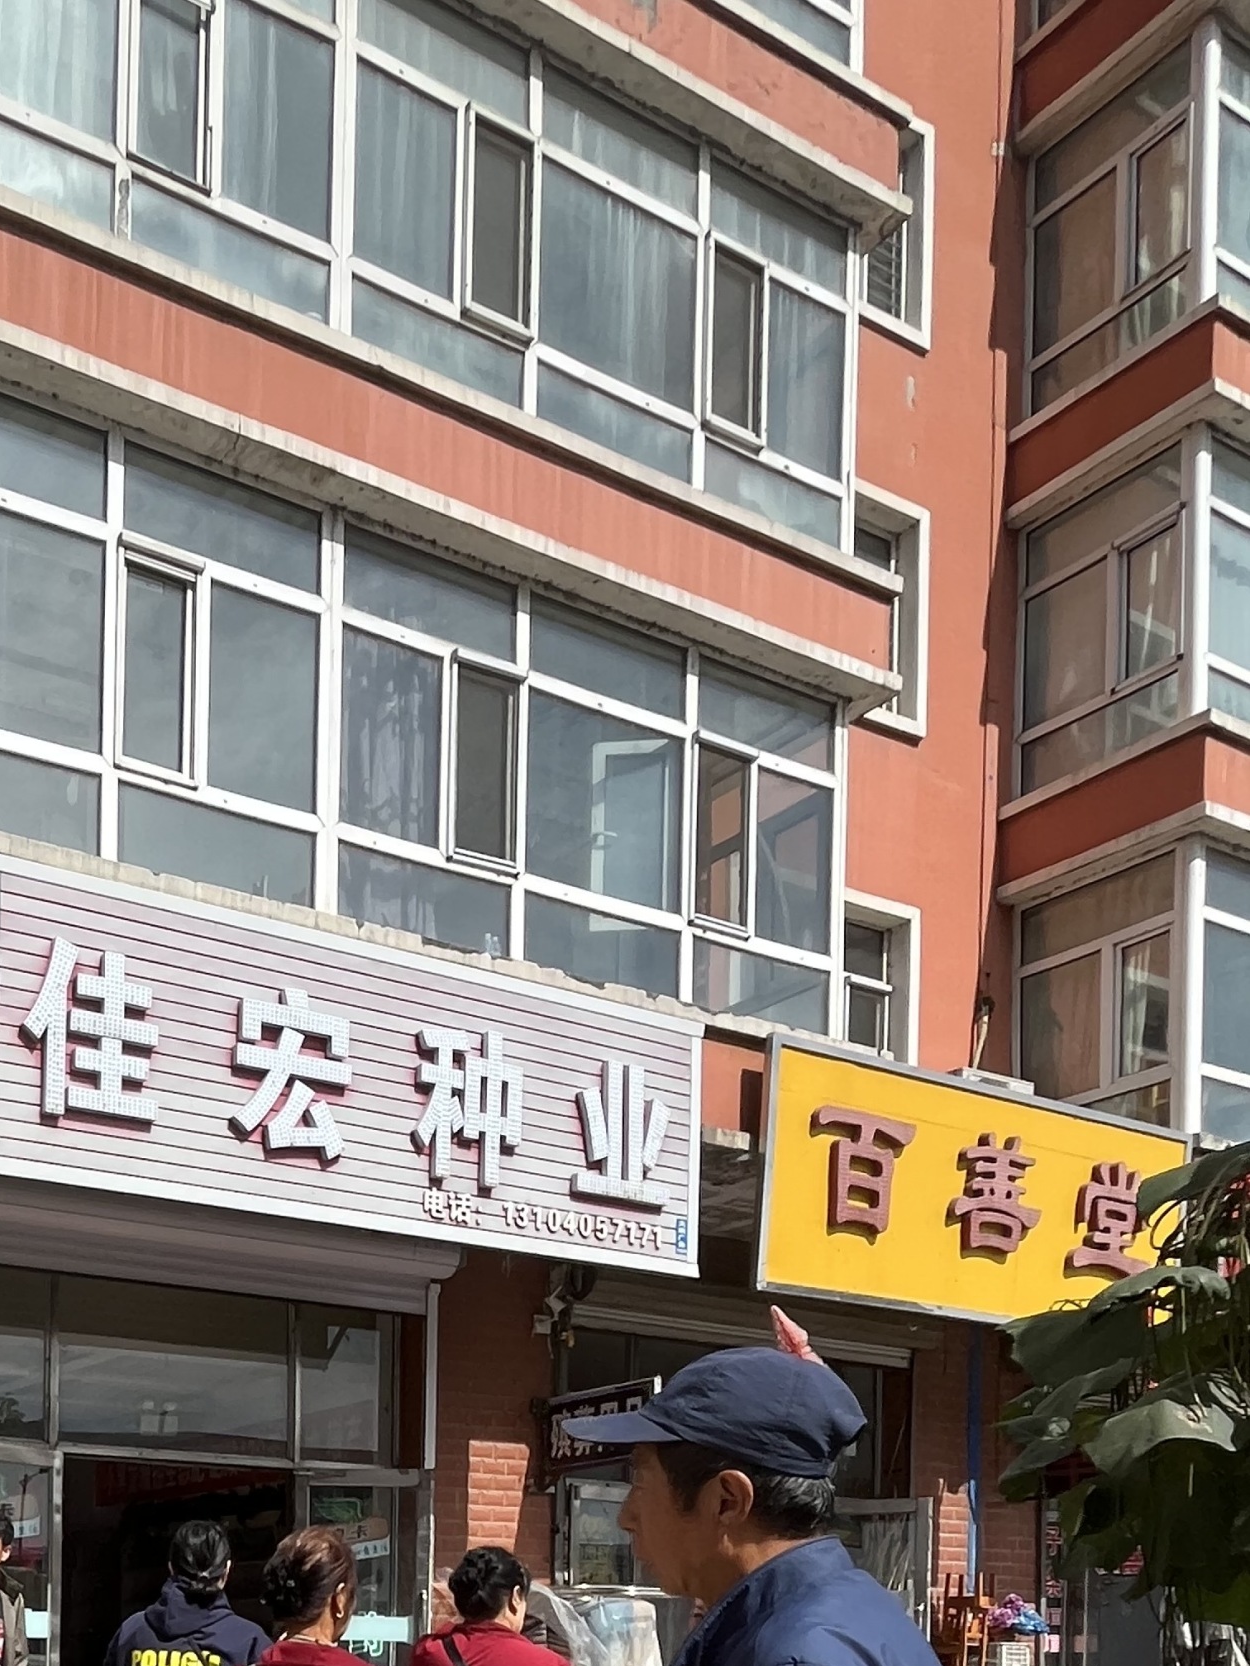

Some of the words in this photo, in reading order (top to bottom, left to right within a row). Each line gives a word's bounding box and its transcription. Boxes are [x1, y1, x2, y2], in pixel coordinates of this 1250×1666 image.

[21, 936, 672, 1207] 佳宏种业
[502, 1201, 663, 1250] 13104057171
[810, 1104, 1154, 1282] 百善堂
